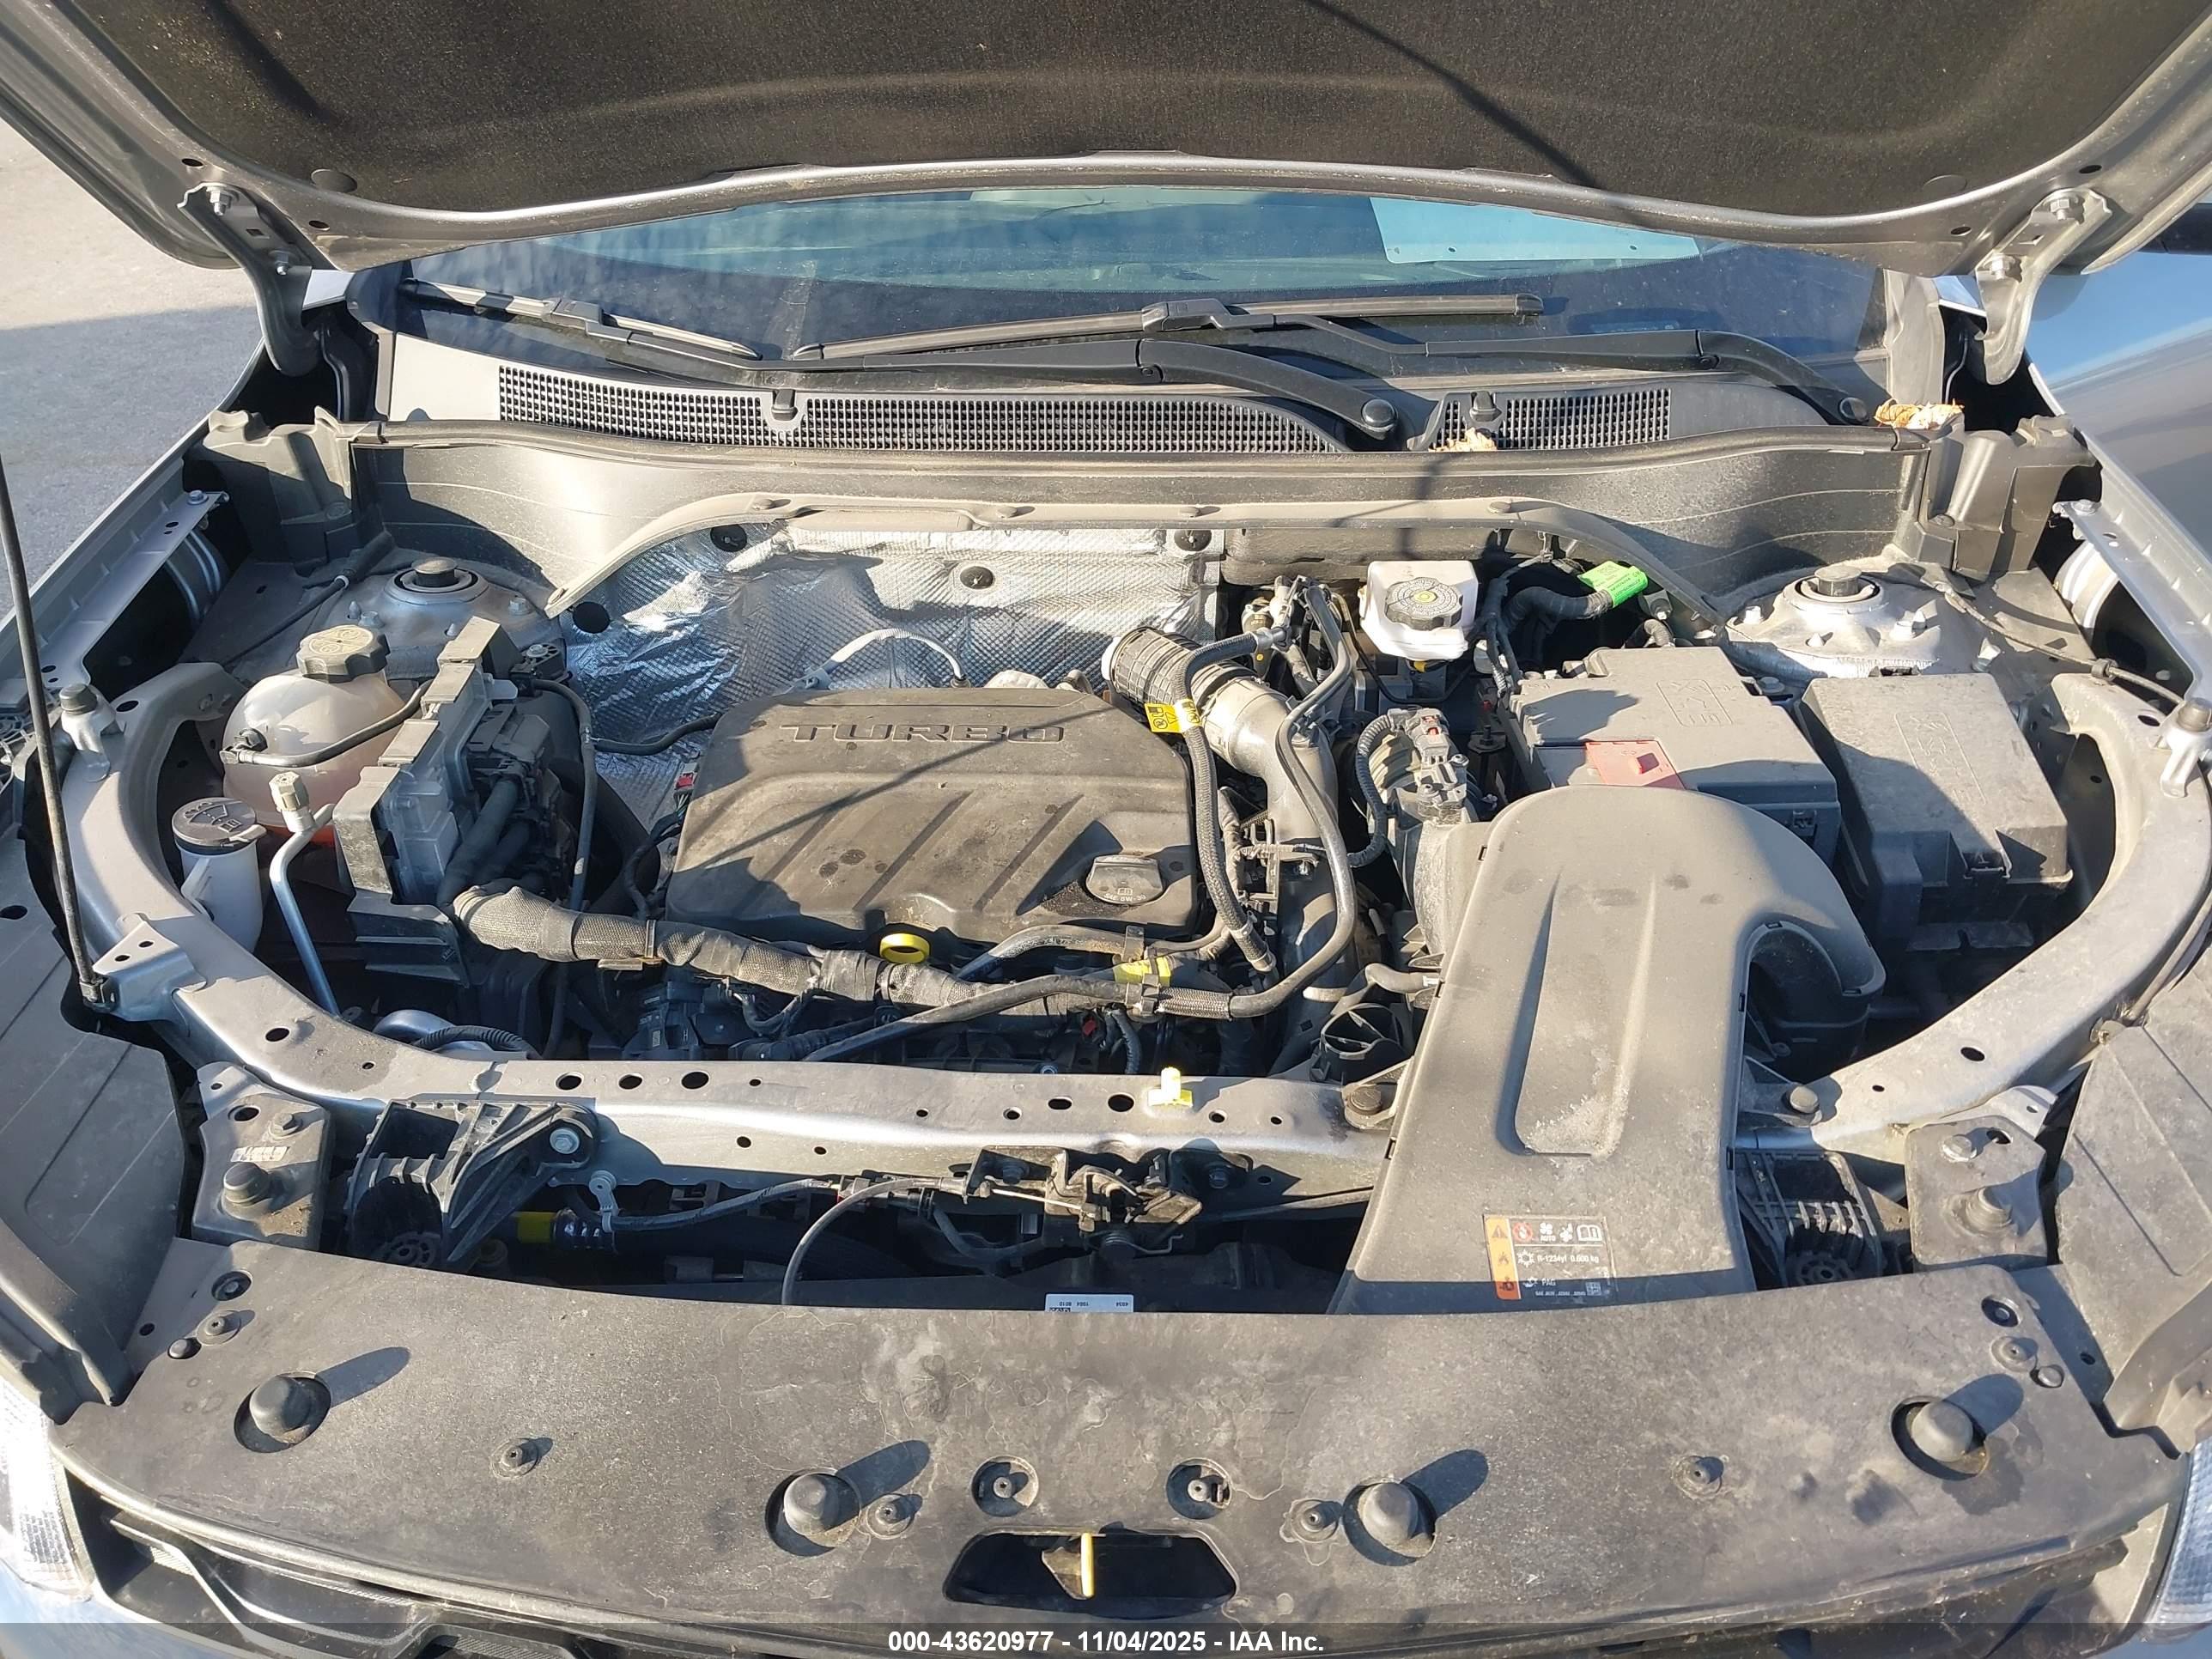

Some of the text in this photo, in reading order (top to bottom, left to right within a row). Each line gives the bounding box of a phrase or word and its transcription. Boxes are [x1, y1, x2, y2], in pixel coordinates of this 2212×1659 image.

[779, 723, 1065, 744] TURBO
[1537, 1255, 1567, 1263] R-1234yf
[1590, 1255, 1599, 1263] kg
